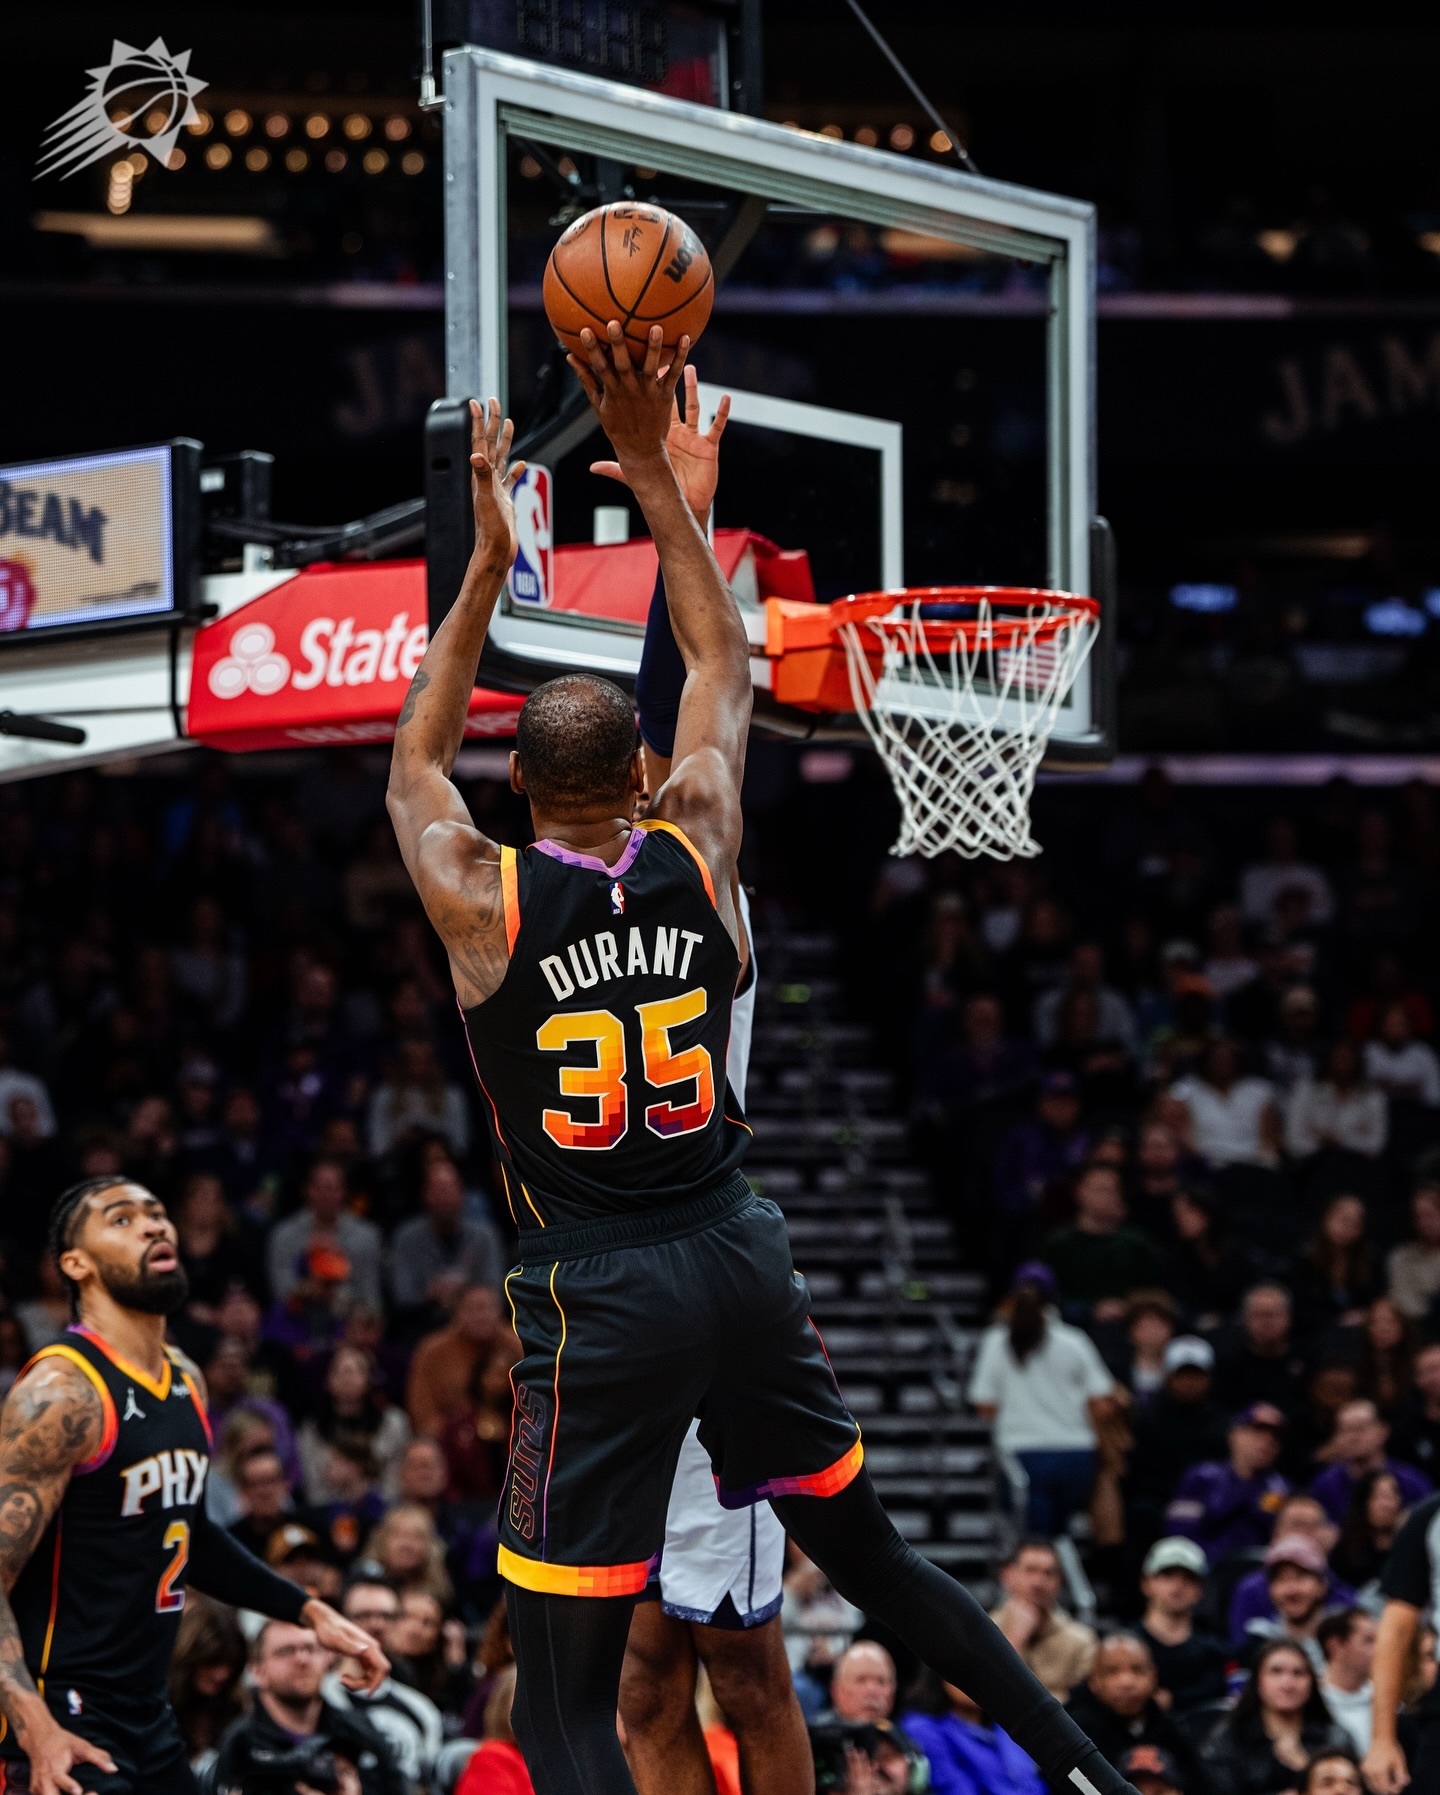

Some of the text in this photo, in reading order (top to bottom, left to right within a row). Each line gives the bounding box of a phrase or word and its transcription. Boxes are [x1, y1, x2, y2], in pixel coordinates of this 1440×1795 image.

[293, 612, 428, 690] State
[538, 926, 704, 1001] DURANT
[536, 988, 716, 1150] 35
[155, 1520, 190, 1613] 2
